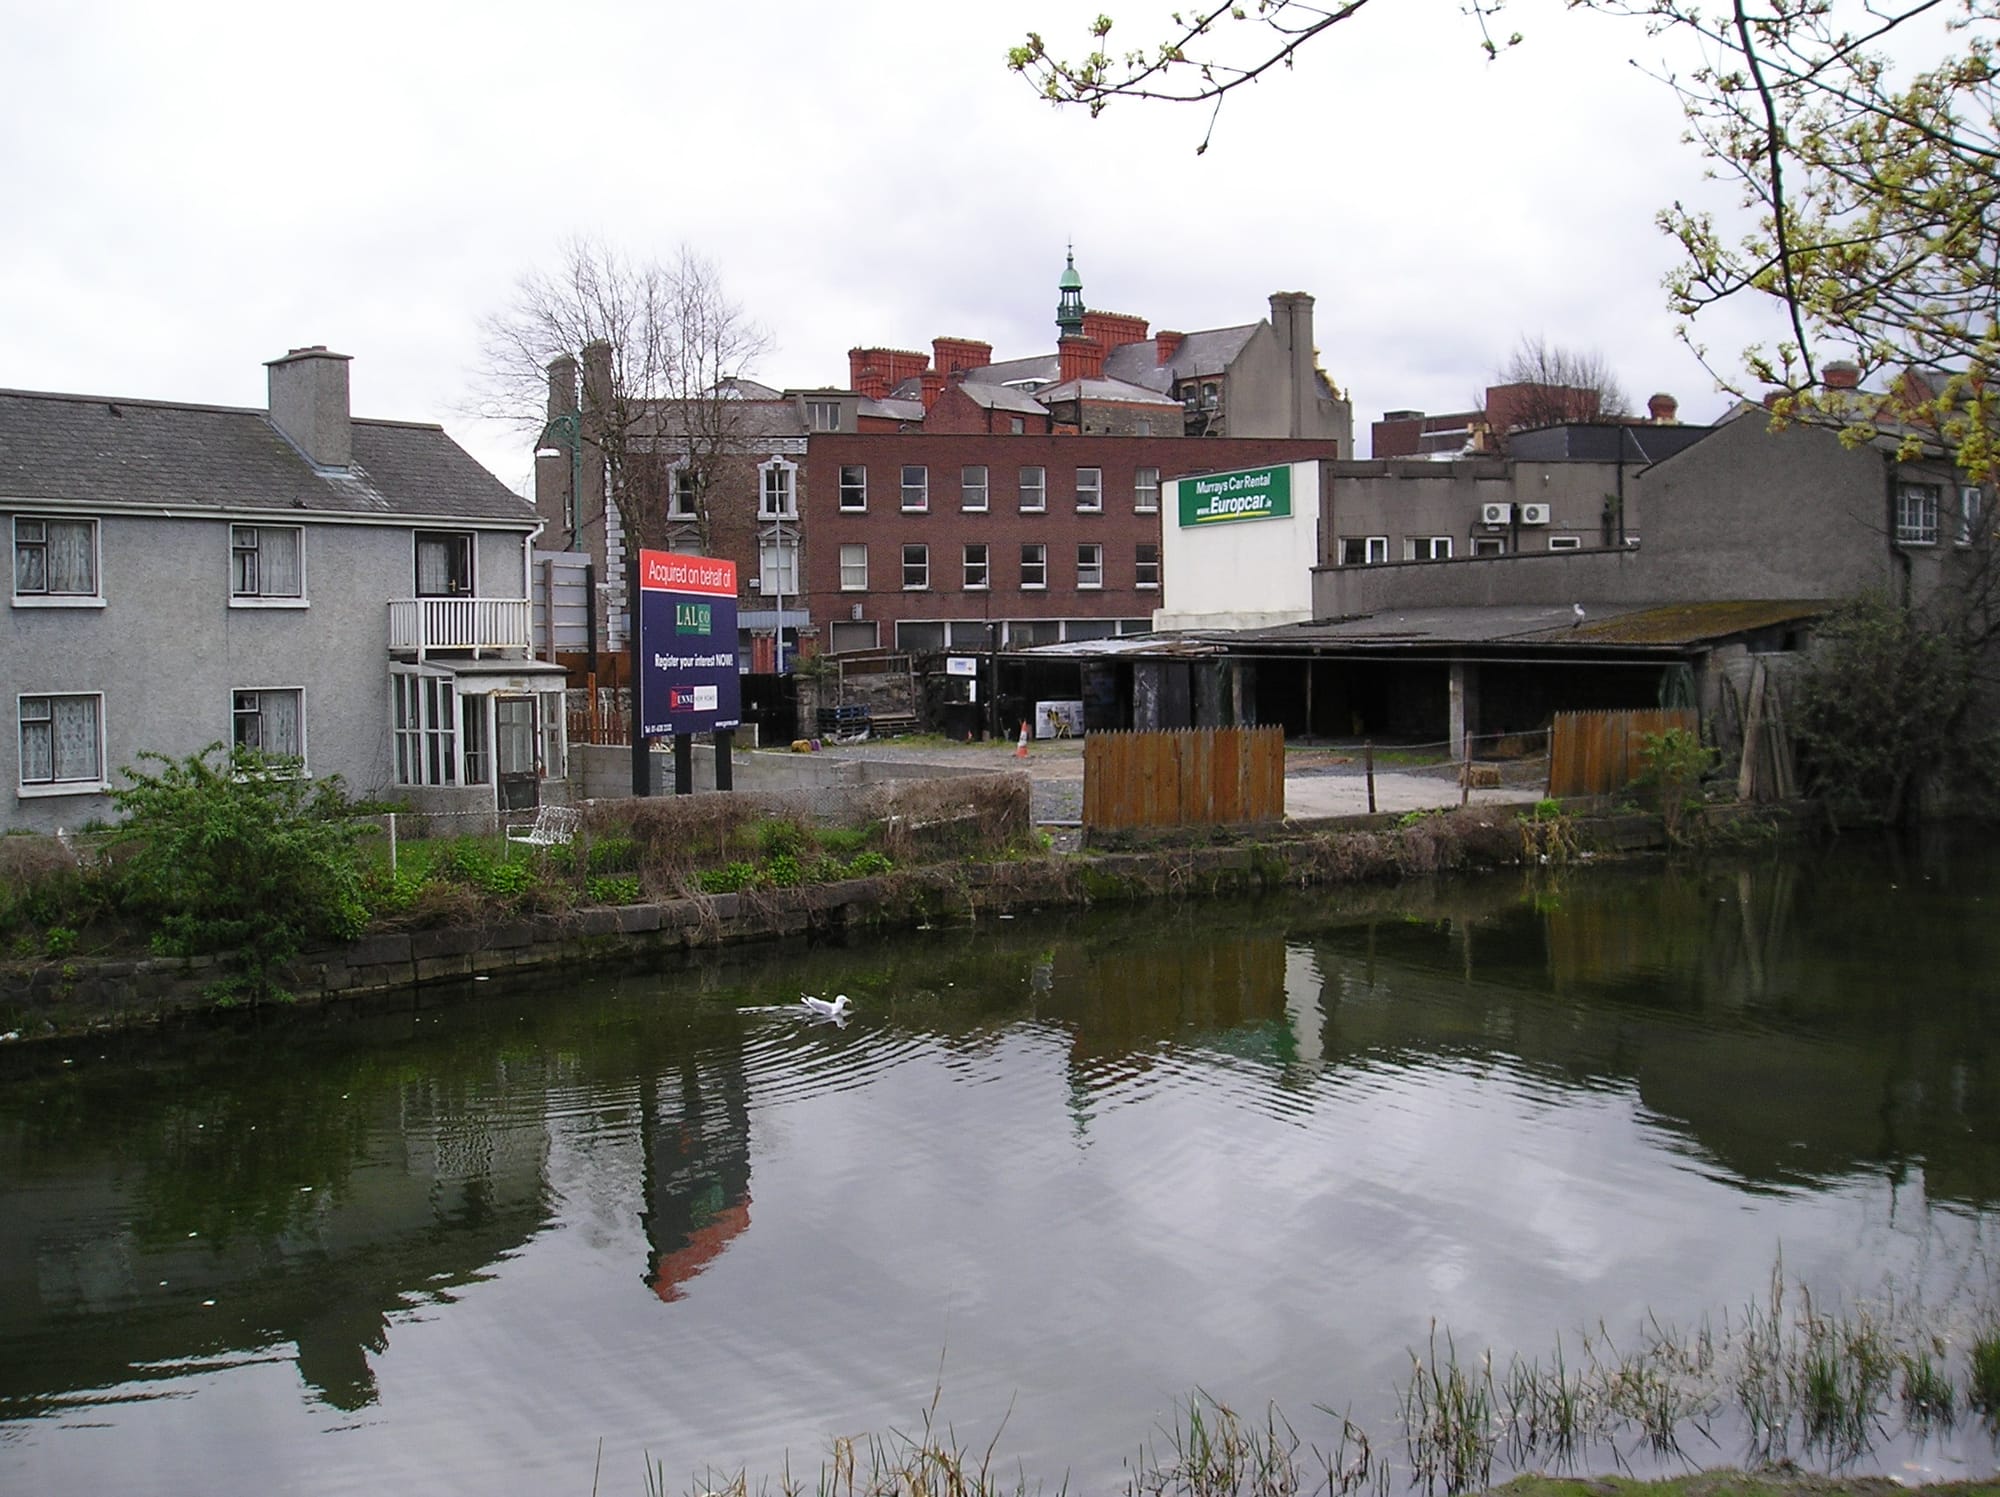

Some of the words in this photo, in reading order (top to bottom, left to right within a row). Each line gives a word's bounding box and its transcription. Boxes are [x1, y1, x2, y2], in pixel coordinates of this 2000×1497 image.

[1196, 480, 1228, 494] Murrays
[1229, 477, 1244, 490] Car
[1244, 473, 1271, 488] Rental
[648, 559, 687, 586] Acquired
[688, 568, 699, 584] on
[700, 565, 722, 587] behalf
[723, 569, 731, 588] of
[655, 652, 679, 670] Register
[679, 656, 694, 670] your
[694, 653, 715, 666] interest
